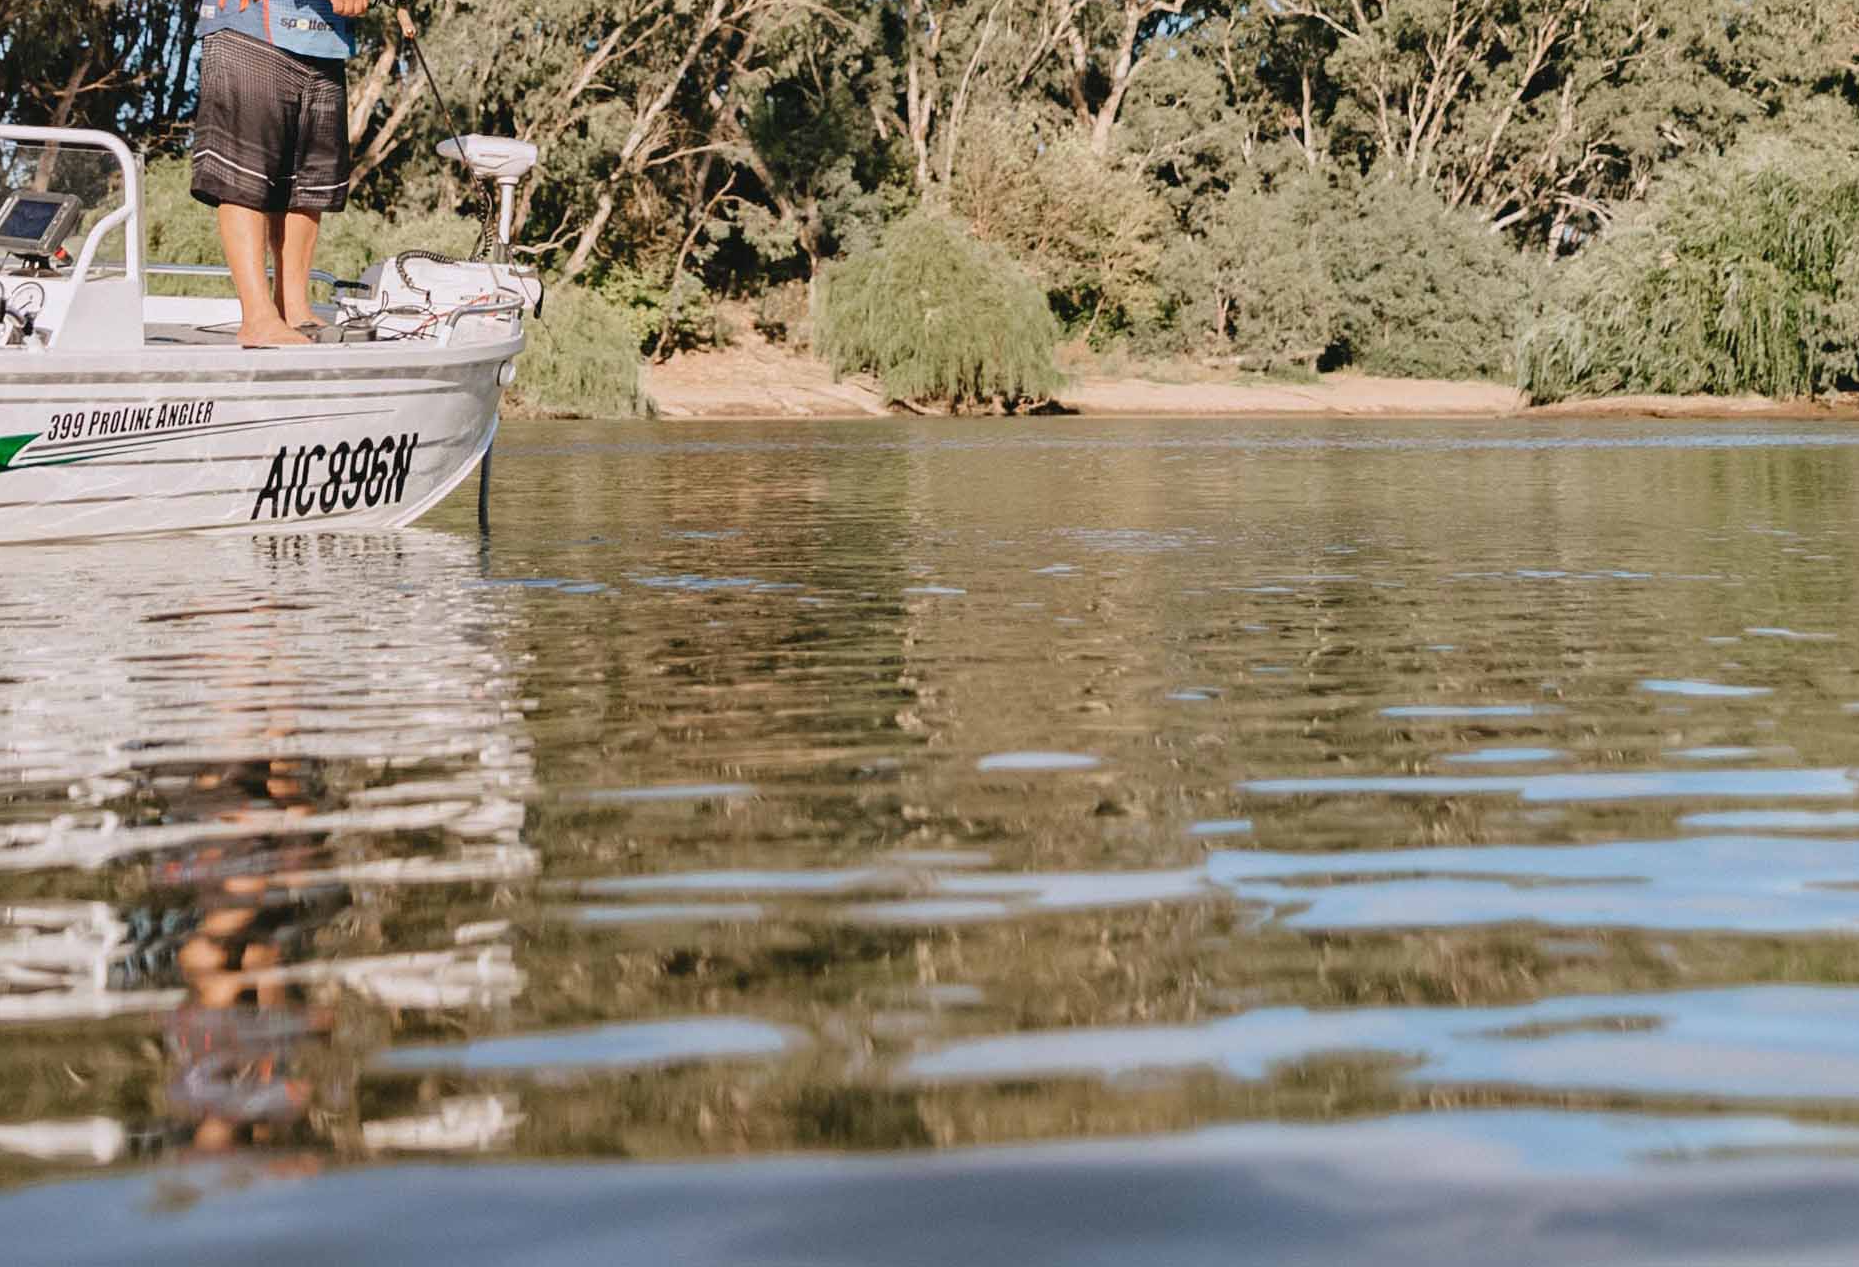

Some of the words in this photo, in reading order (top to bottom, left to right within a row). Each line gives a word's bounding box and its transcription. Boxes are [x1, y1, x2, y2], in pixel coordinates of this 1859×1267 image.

[48, 412, 85, 441] 399
[156, 401, 214, 429] ANGLER
[250, 432, 419, 520] AIC896N
